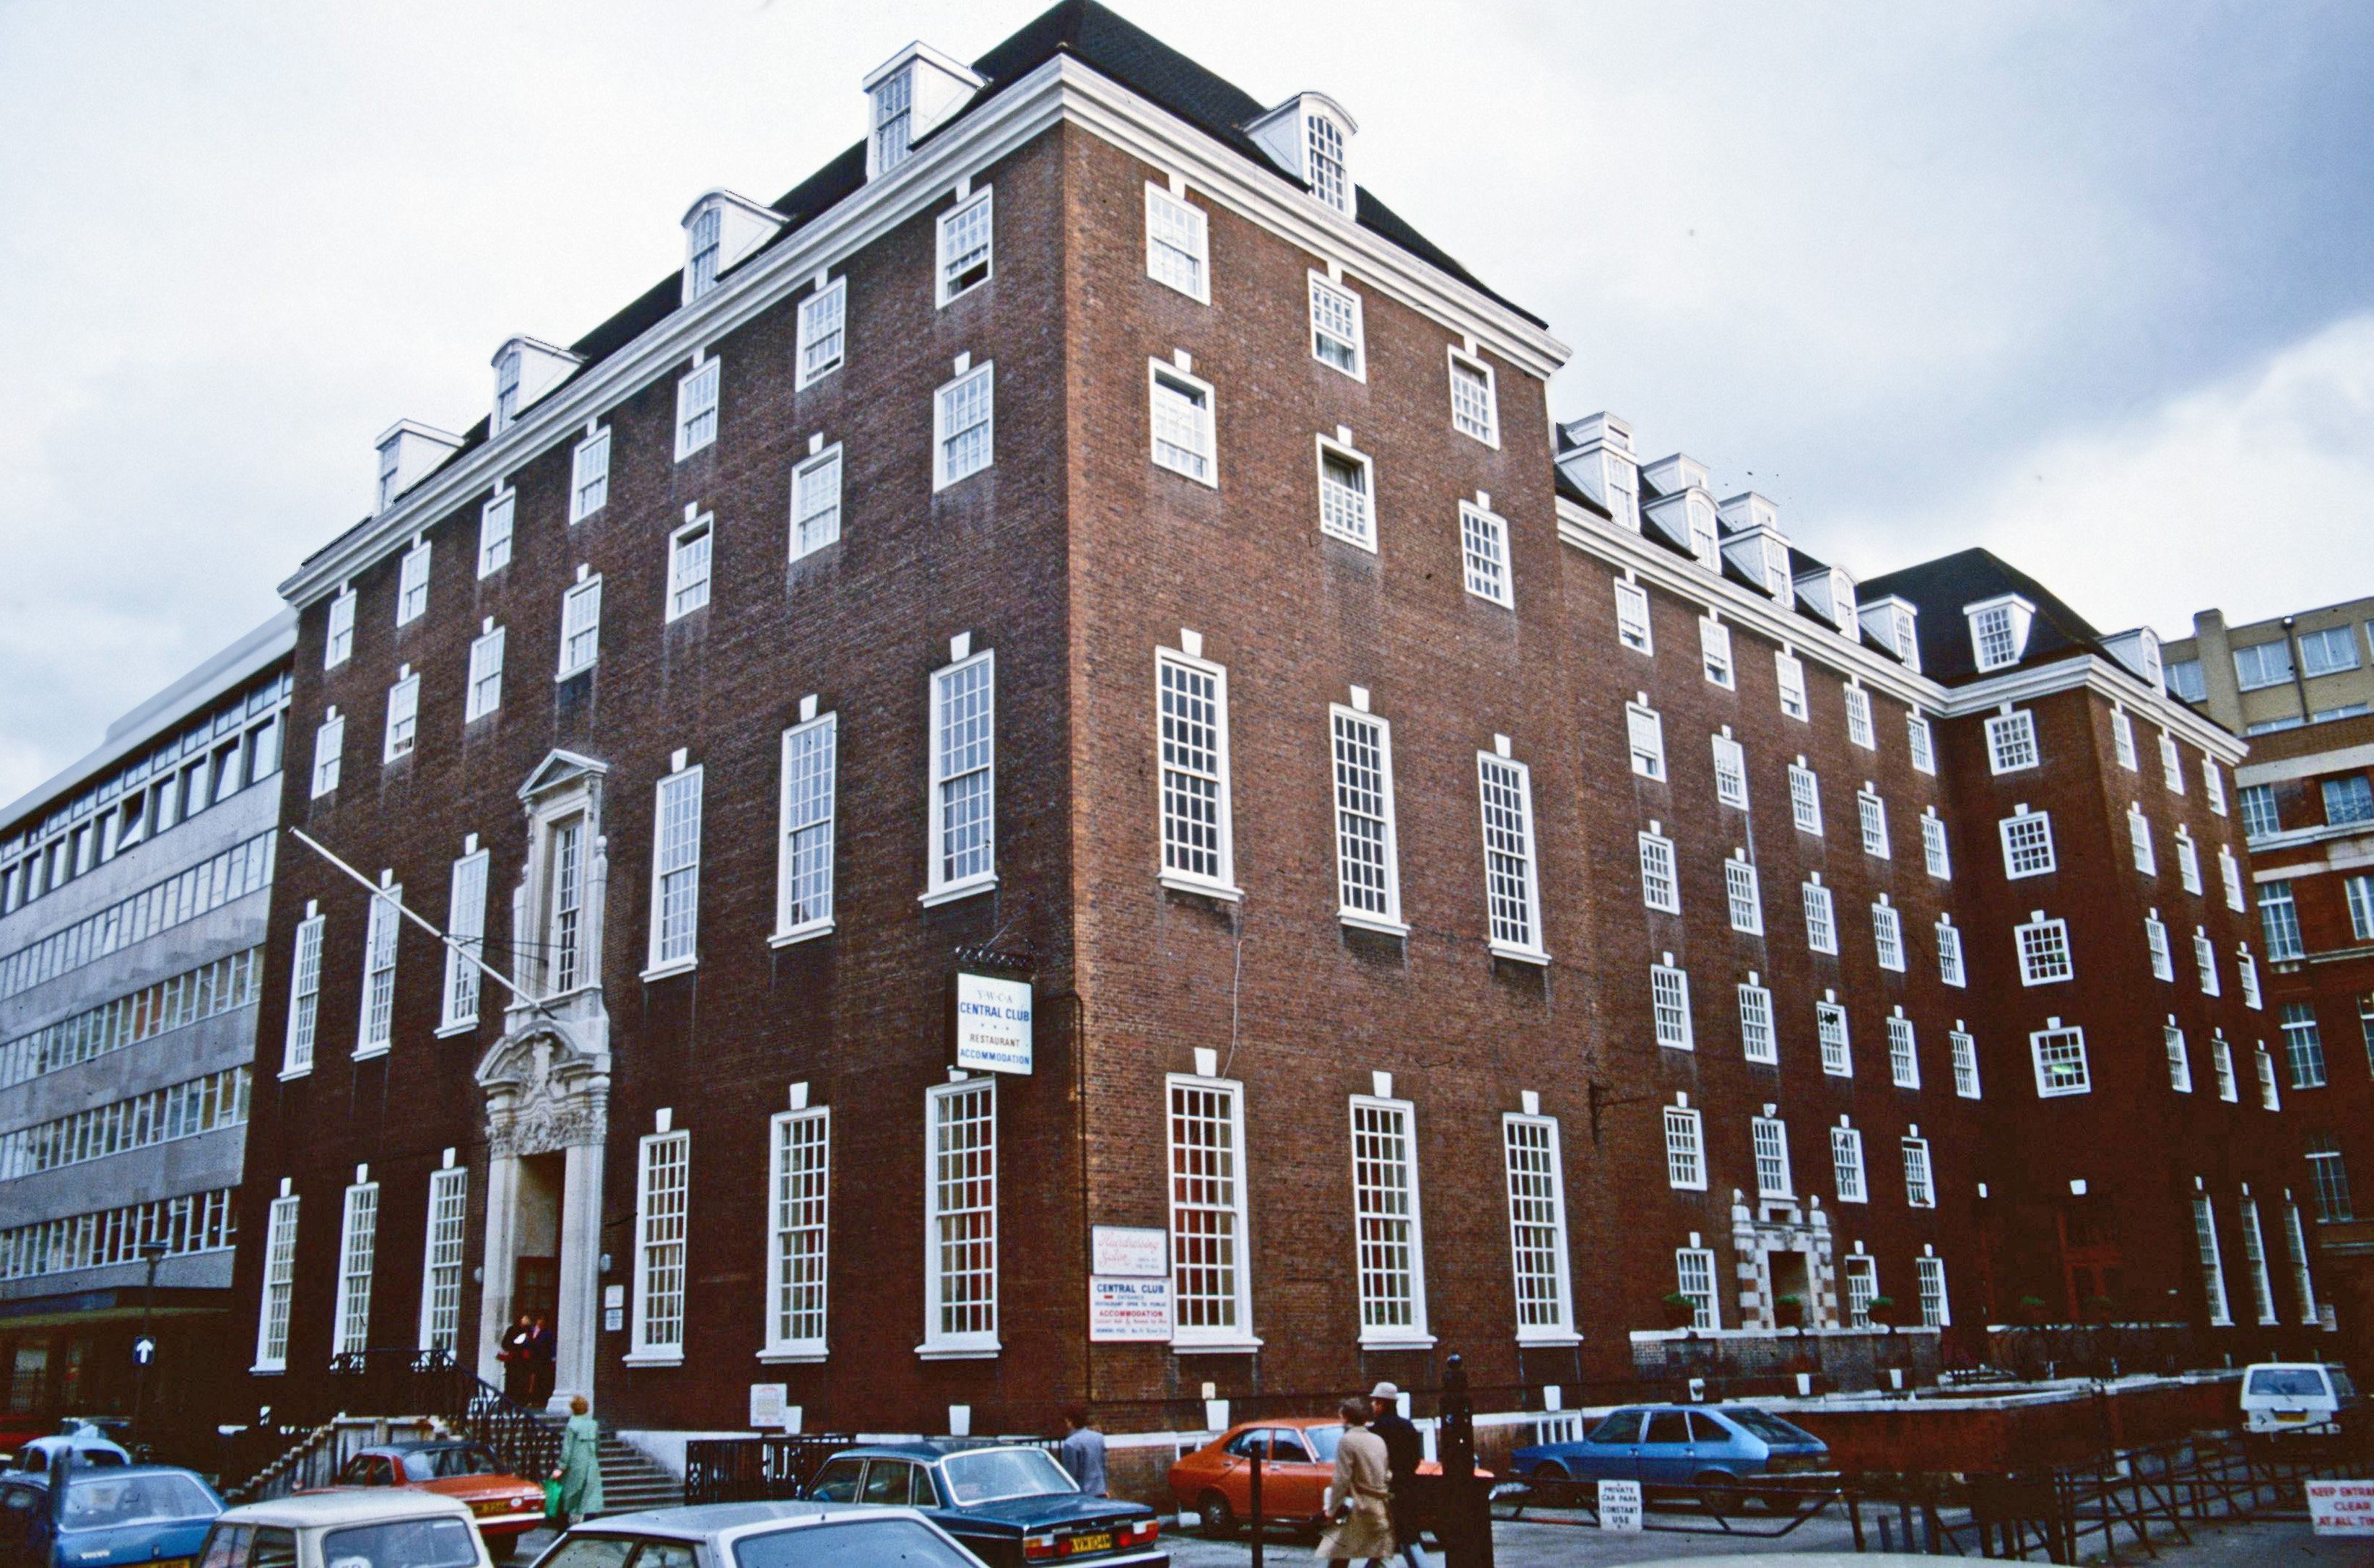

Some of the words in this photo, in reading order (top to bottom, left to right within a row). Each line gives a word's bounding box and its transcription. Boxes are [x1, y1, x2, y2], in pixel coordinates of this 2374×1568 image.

[960, 1001, 1002, 1018] CENTRAL
[1005, 1008, 1030, 1022] CLUB
[969, 1033, 1020, 1047] RESTAURANT
[960, 1048, 1030, 1065] ACCOMMODATION
[1097, 1284, 1136, 1294] CENTRAL
[1142, 1284, 1165, 1294] CLUB
[2310, 1486, 2336, 1497] KEEP
[1601, 1505, 1638, 1514] CONSTANT
[2334, 1501, 2371, 1512] CLEAR
[1612, 1515, 1630, 1524] USE
[2318, 1516, 2332, 1527] AT
[2334, 1516, 2357, 1527] ALL
